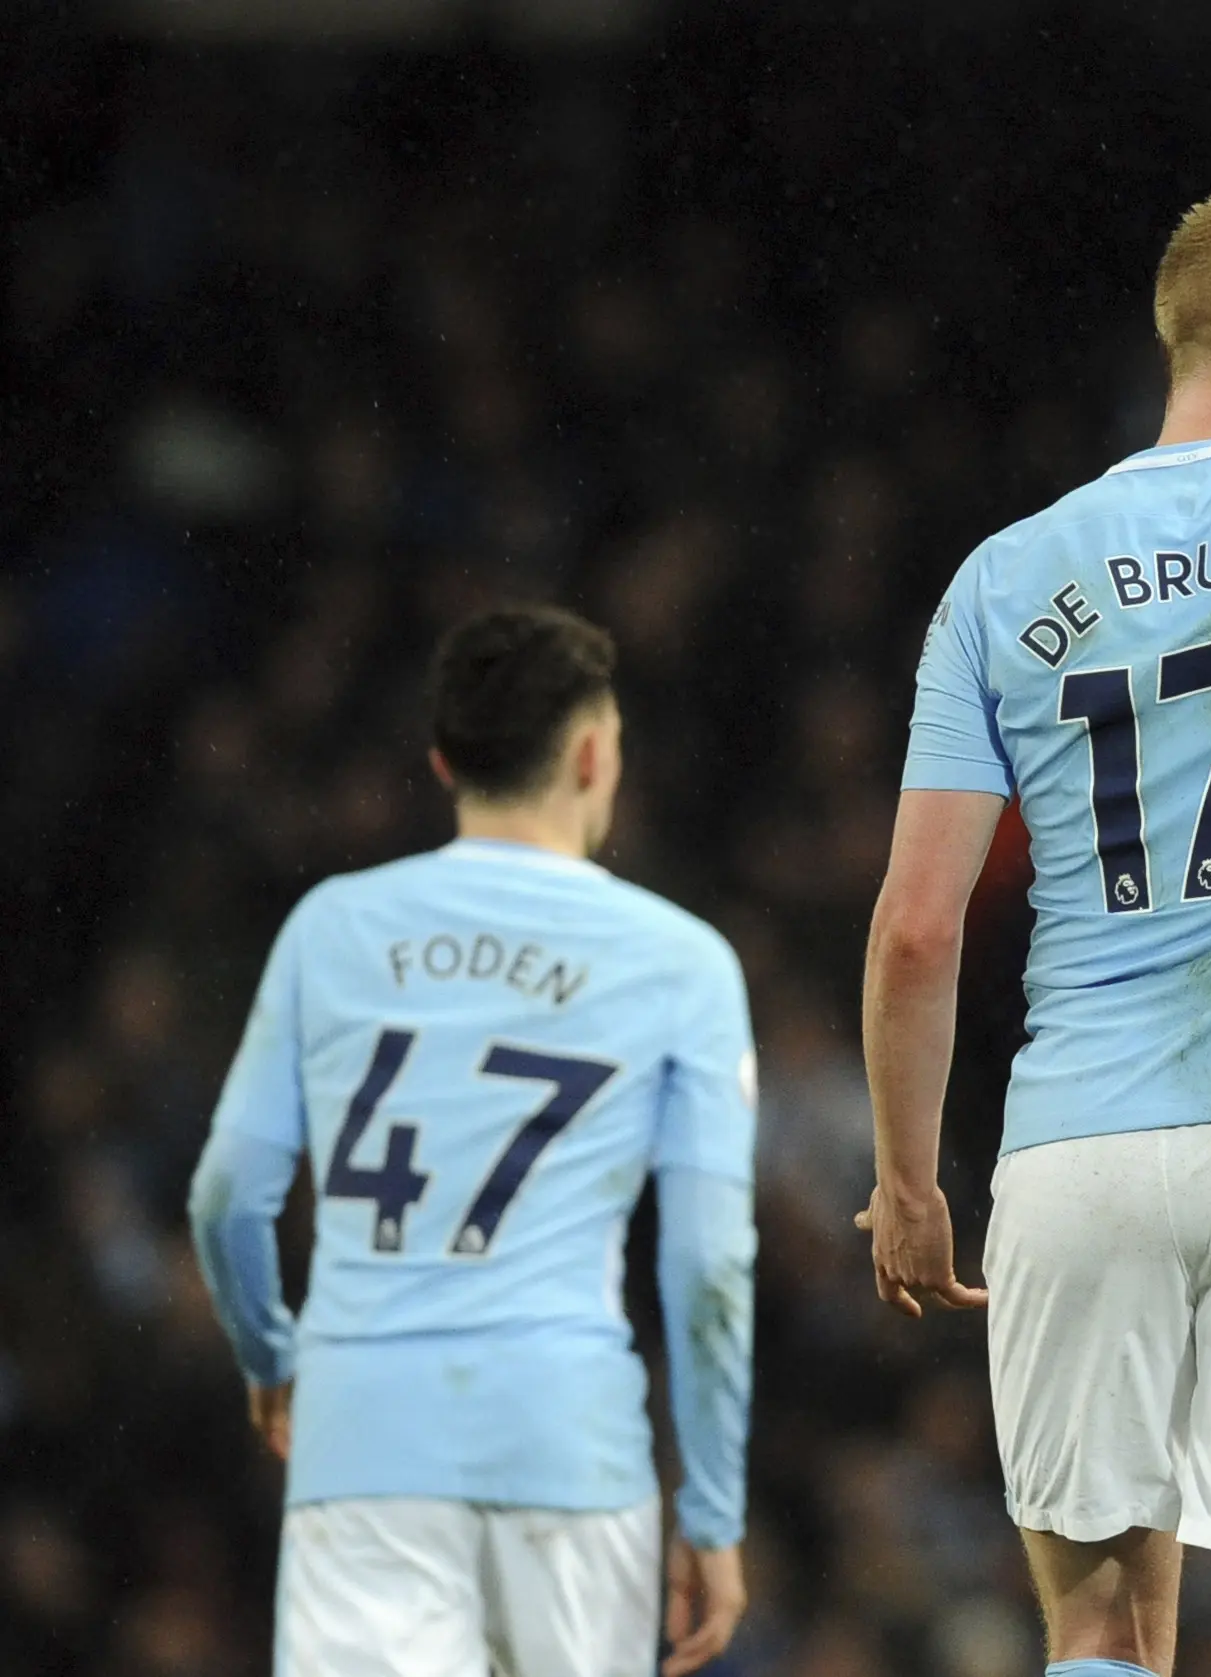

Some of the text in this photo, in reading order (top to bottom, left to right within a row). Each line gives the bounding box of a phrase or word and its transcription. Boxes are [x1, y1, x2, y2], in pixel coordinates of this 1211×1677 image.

[1017, 580, 1102, 670] DE
[387, 932, 592, 1006] FODEN
[321, 1022, 623, 1259] 47
